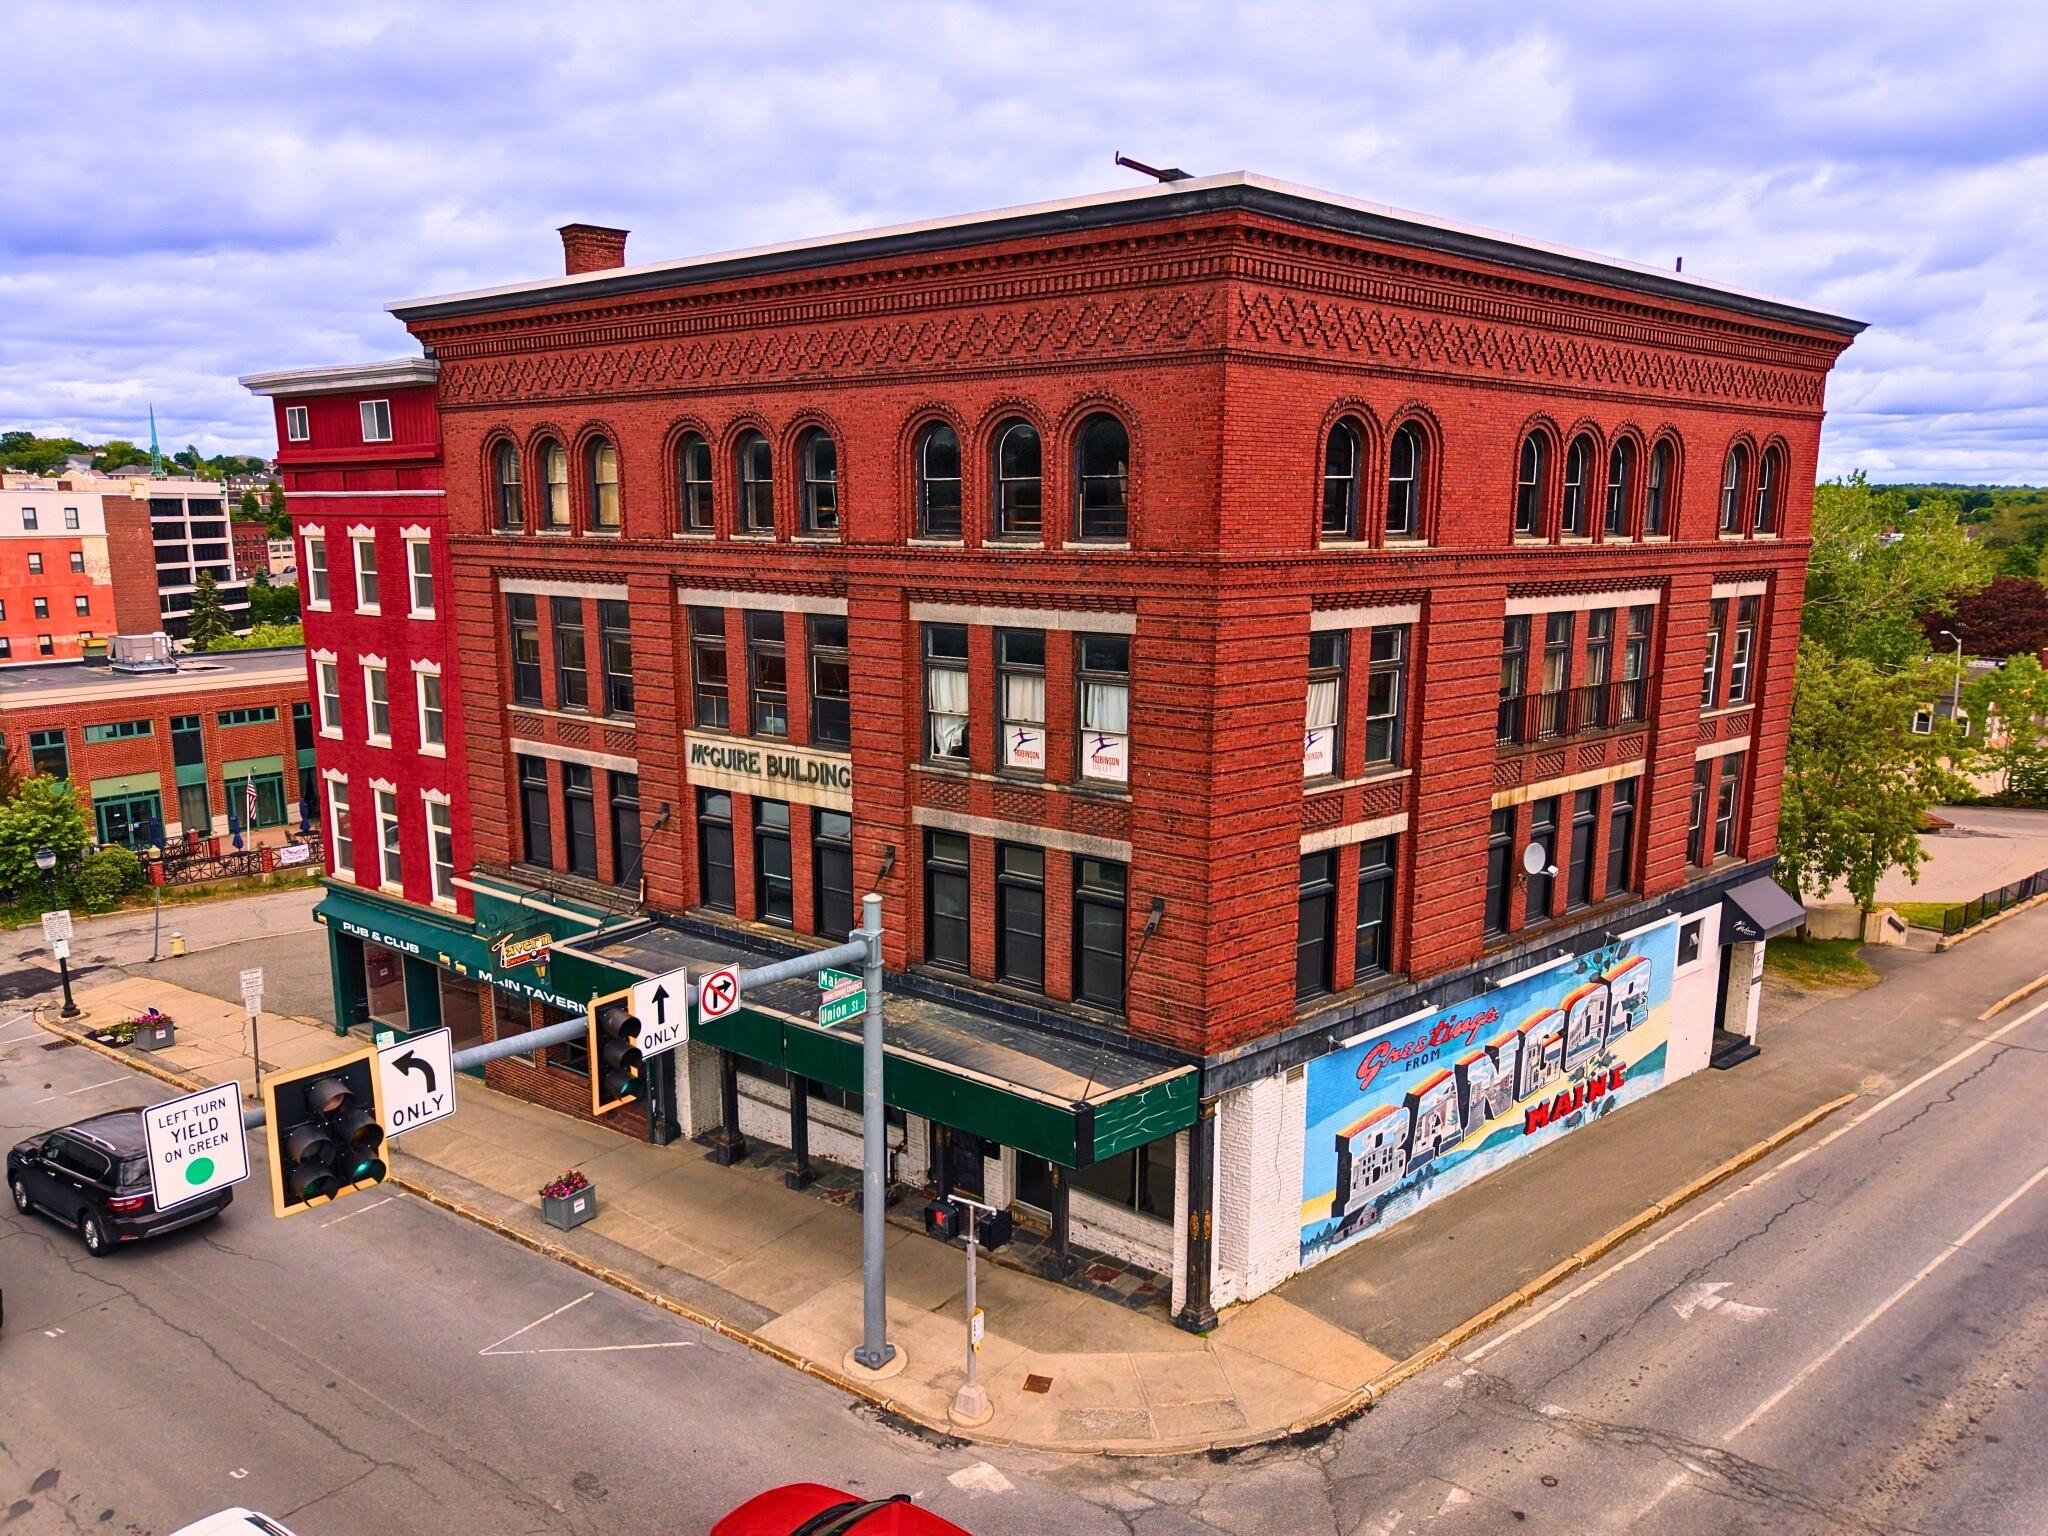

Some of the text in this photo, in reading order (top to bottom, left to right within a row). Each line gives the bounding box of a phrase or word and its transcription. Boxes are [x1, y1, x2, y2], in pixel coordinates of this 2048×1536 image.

[1014, 749, 1040, 760] ROBINSON
[1092, 755, 1120, 767] ROBINSON
[766, 754, 851, 789] BUILDING
[343, 921, 420, 954] PUB & CLUB
[491, 932, 552, 968] Tavern
[821, 970, 838, 987] Mai
[821, 1000, 859, 1024] Union St
[644, 1024, 680, 1050] ONLY
[1356, 1007, 1499, 1090] Greetings
[1405, 1048, 1440, 1072] FROM
[1331, 956, 1652, 1218] BANGOR
[1523, 1061, 1627, 1136] MAINE
[158, 1097, 227, 1129] LEFT TURN
[393, 1094, 444, 1127] ONLY
[171, 1116, 219, 1144] YIELD
[165, 1132, 229, 1163] ON GREEN
